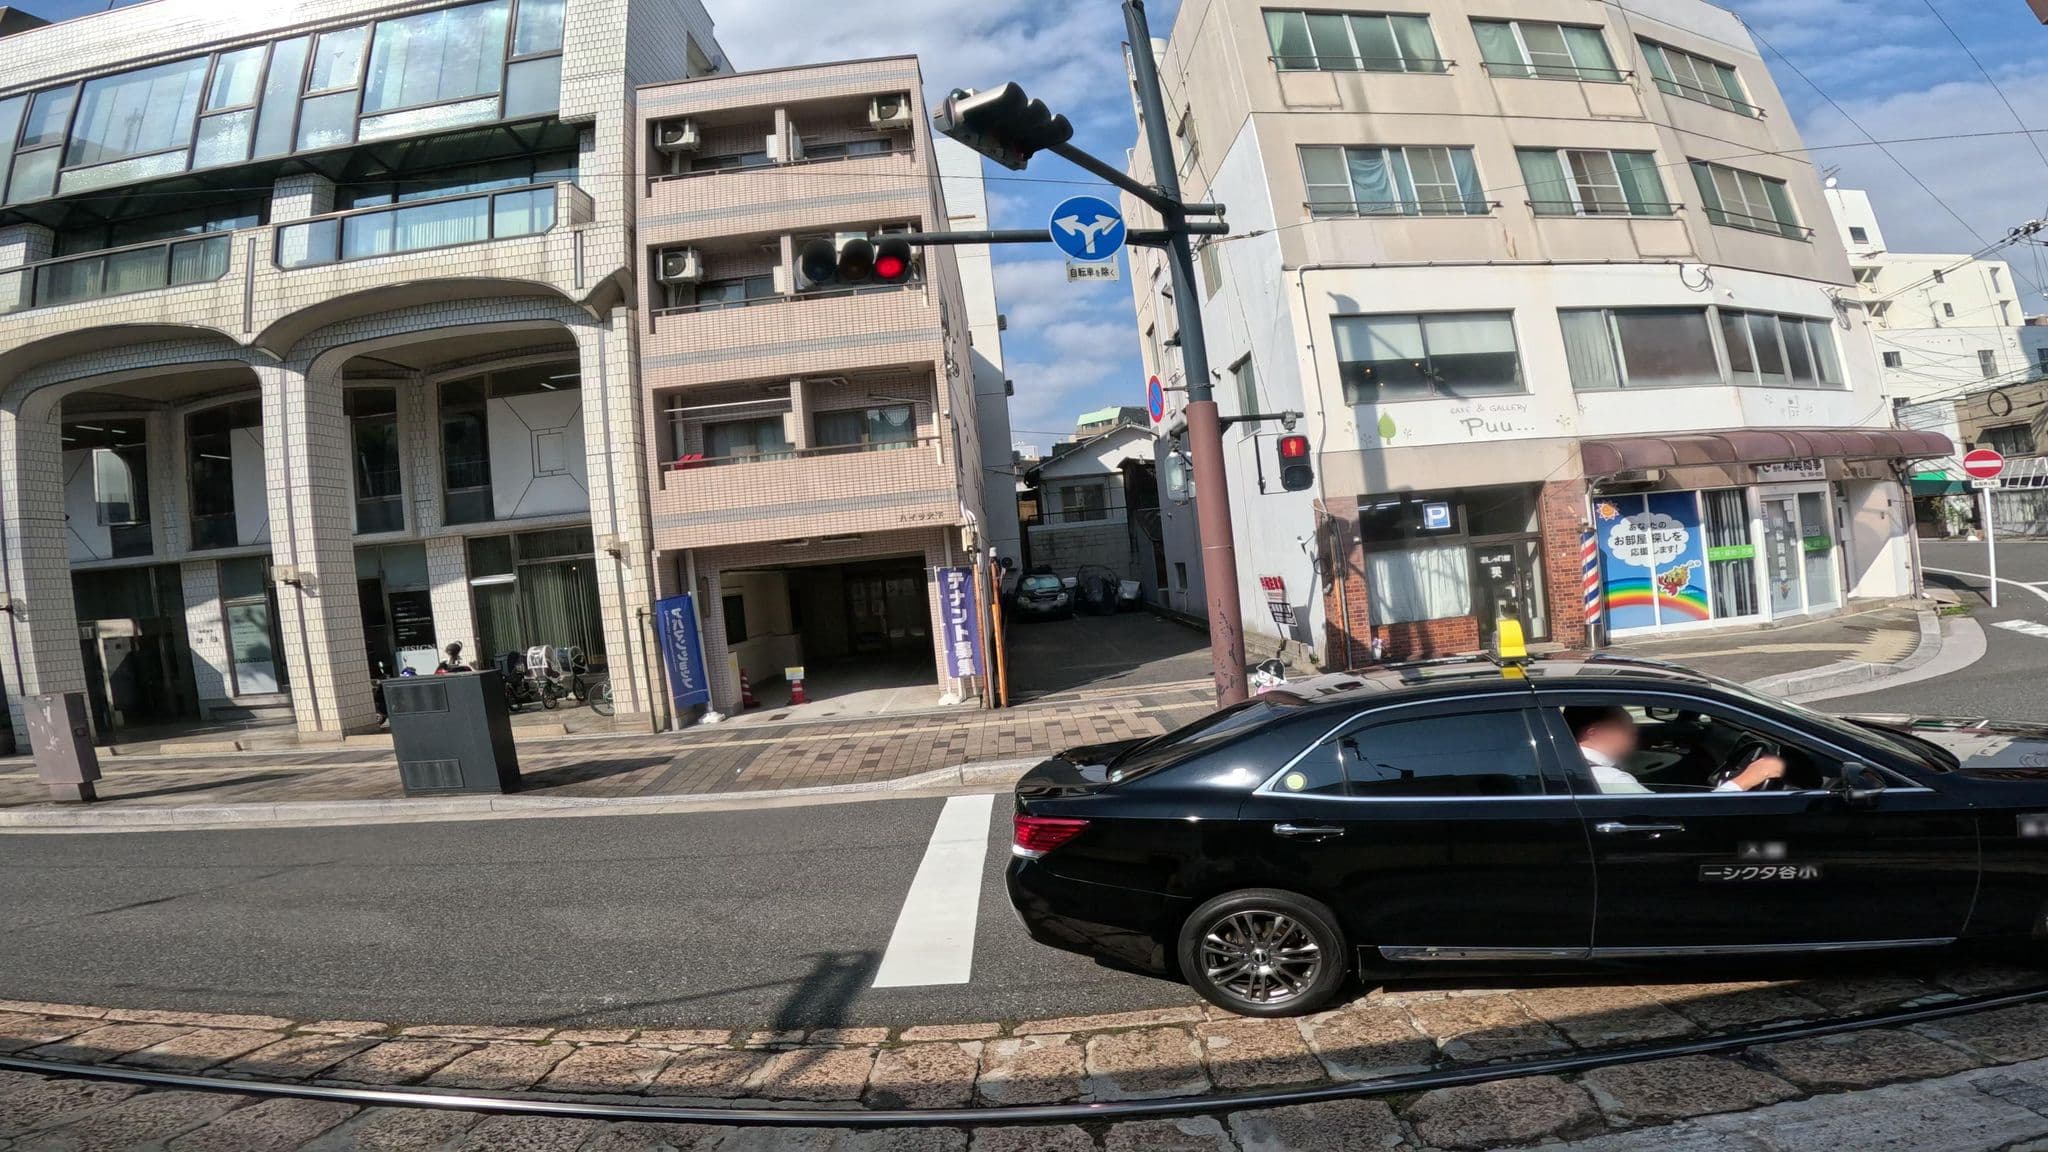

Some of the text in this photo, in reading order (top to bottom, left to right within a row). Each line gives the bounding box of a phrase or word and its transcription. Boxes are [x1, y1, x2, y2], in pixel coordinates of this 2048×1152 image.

[1070, 267, 1115, 278] 自転車を除く
[1489, 403, 1528, 413] GALLERY
[900, 511, 944, 522] ハイツ
[1427, 507, 1446, 527] P
[1629, 521, 1667, 531] あなたの
[1614, 531, 1683, 546] お部屋探しを
